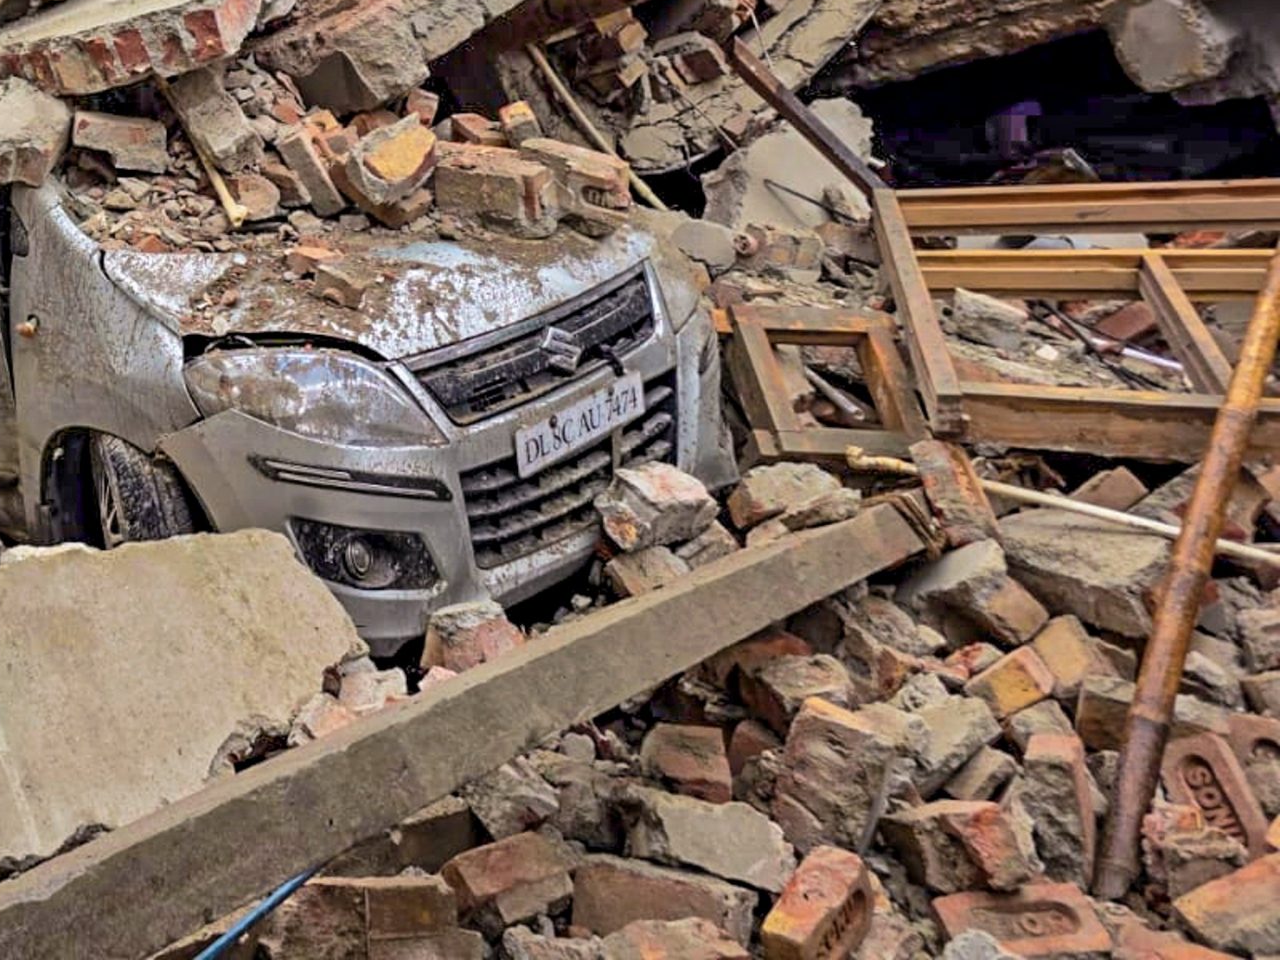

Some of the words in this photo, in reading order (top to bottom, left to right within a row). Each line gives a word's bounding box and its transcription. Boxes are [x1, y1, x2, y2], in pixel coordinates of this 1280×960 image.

[524, 434, 551, 465] DL
[577, 403, 602, 437] AU
[604, 385, 638, 423] 7474
